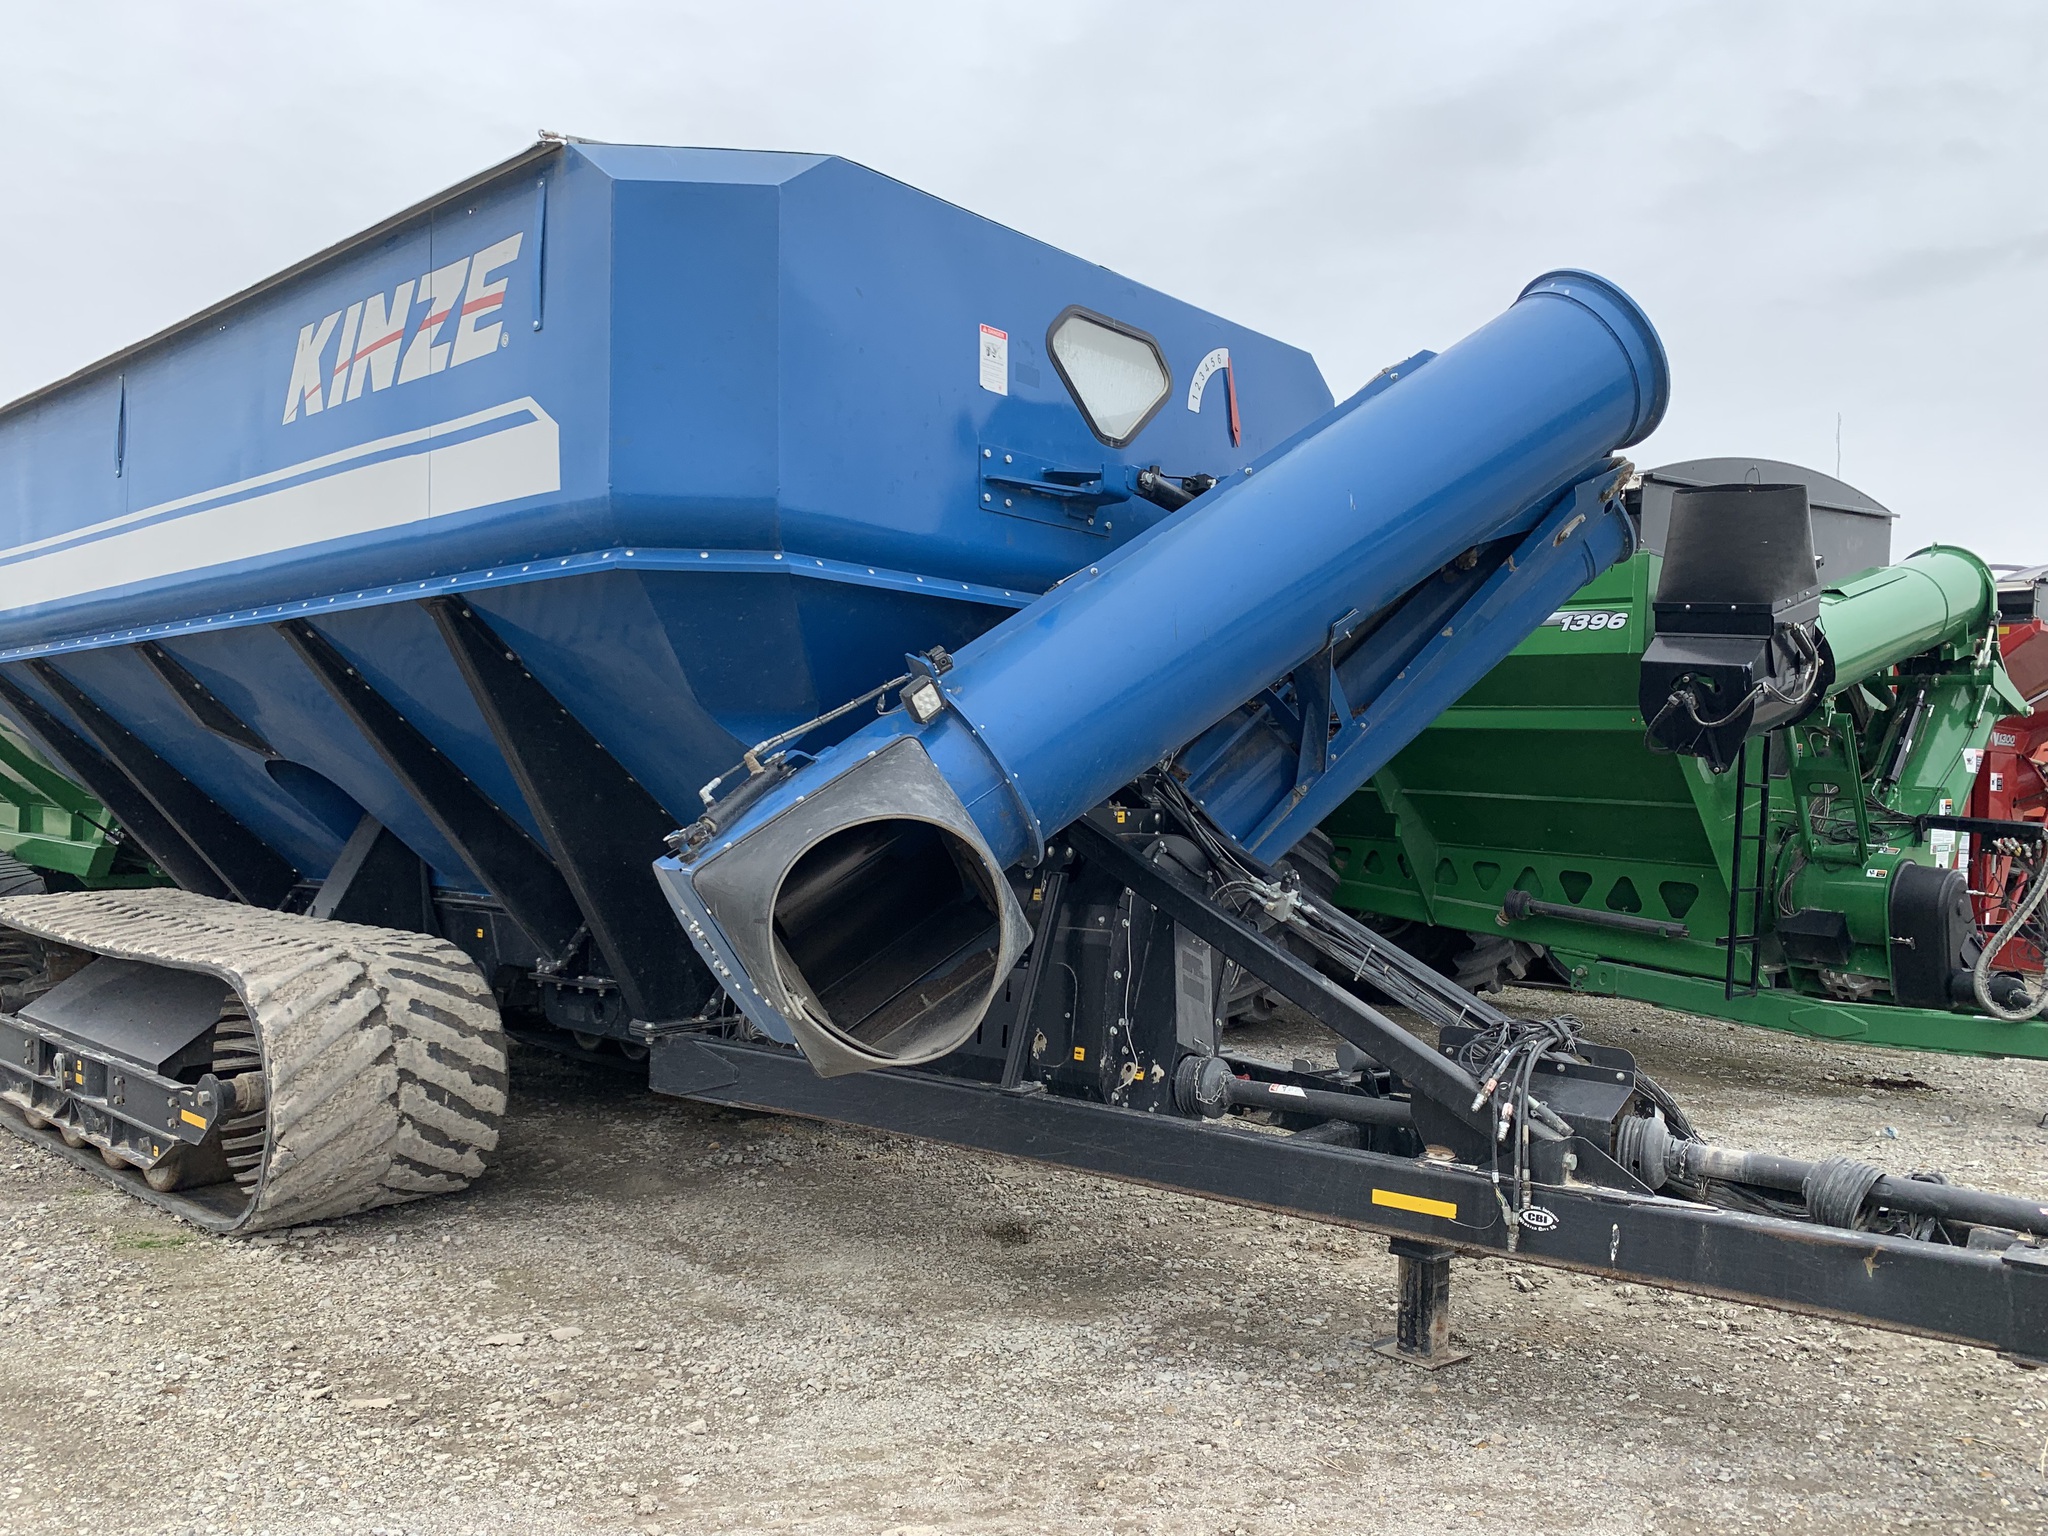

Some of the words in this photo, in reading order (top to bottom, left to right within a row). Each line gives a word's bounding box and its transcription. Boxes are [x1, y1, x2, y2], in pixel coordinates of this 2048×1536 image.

[282, 232, 523, 425] KINZE
[1195, 382, 1201, 391] 2
[1199, 371, 1205, 380] 3
[1210, 357, 1216, 368] 5
[1217, 353, 1222, 364] 6
[1560, 612, 1629, 632] 1396
[1528, 1213, 1548, 1223] CBI
